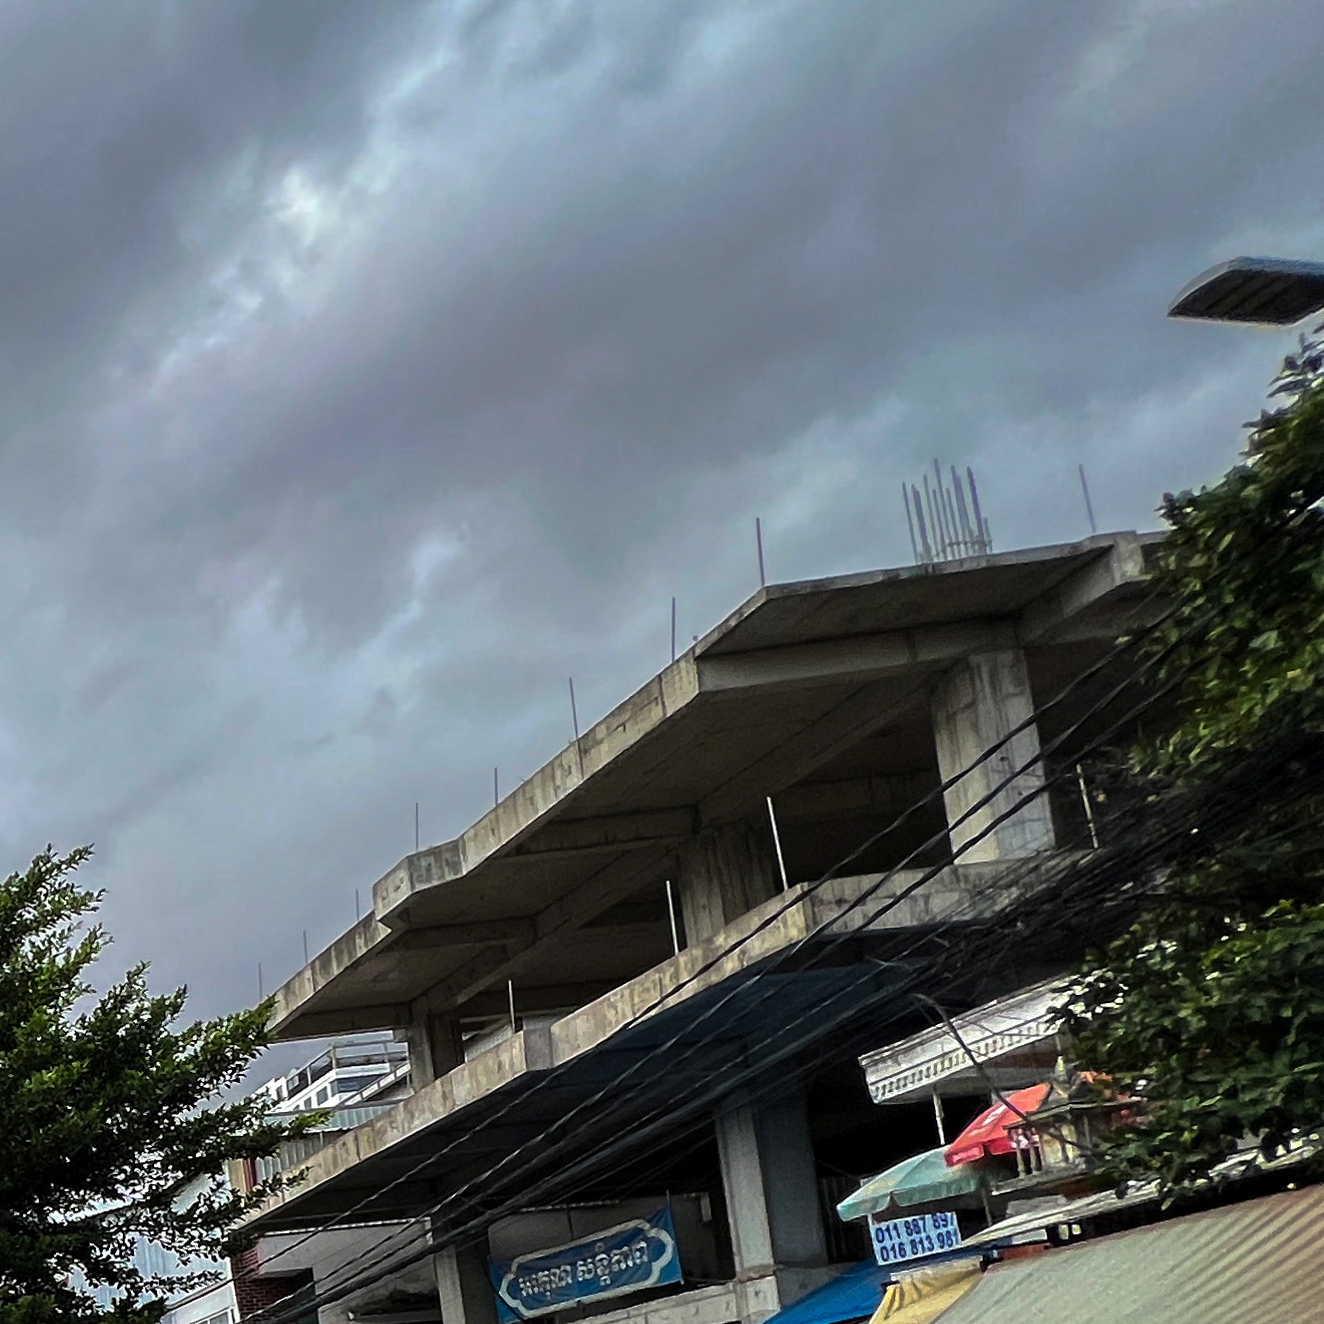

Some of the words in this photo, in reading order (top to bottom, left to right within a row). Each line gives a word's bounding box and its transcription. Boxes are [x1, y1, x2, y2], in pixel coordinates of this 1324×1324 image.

[875, 1222, 901, 1243] 011
[904, 1216, 927, 1237] 887
[880, 1242, 907, 1262] 016
[910, 1235, 935, 1256] 813
